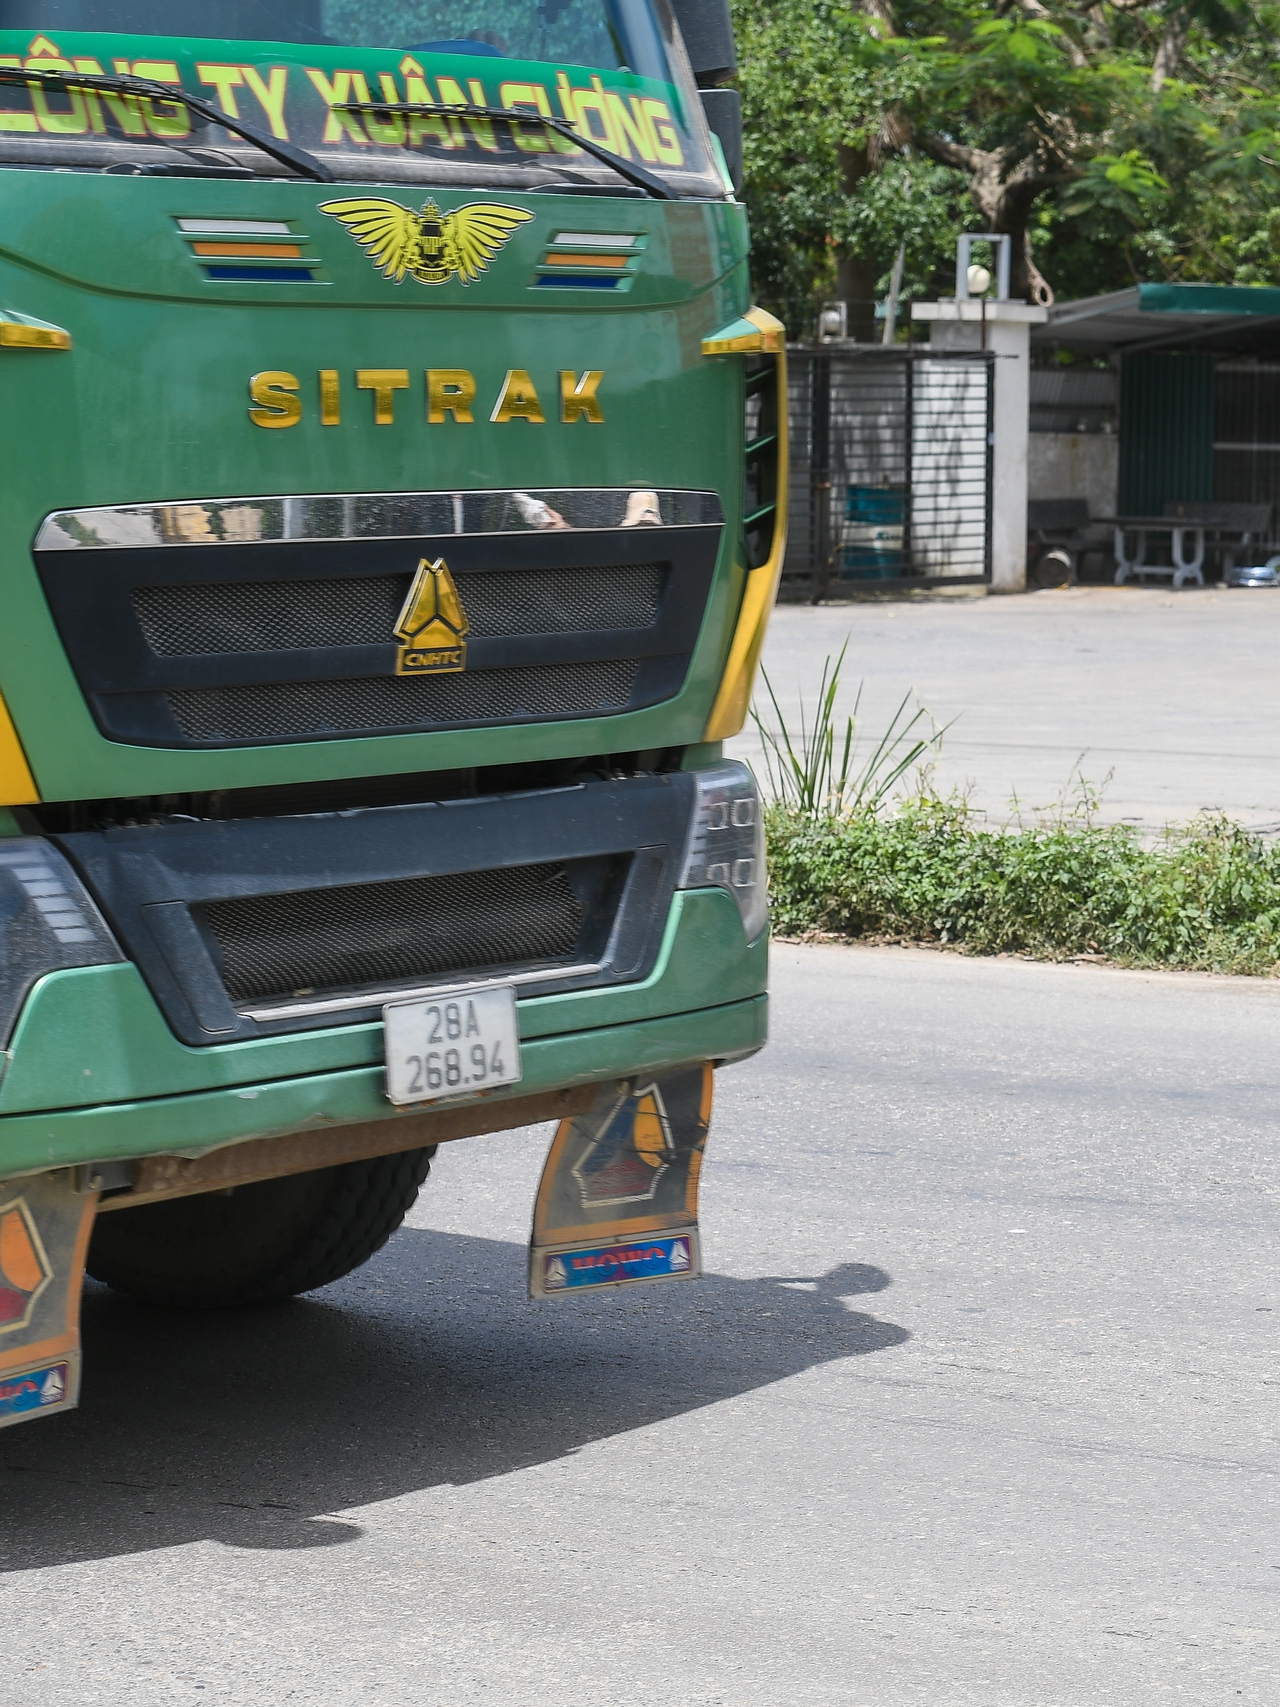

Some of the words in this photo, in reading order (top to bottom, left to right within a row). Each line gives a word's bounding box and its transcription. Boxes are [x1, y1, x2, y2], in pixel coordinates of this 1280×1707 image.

[196, 62, 289, 140] TY
[305, 54, 498, 151] XUÂN
[248, 368, 605, 429] SITRAK
[404, 650, 461, 666] CNHTC
[426, 1000, 480, 1044] 28A
[406, 1040, 504, 1094] 268.94
